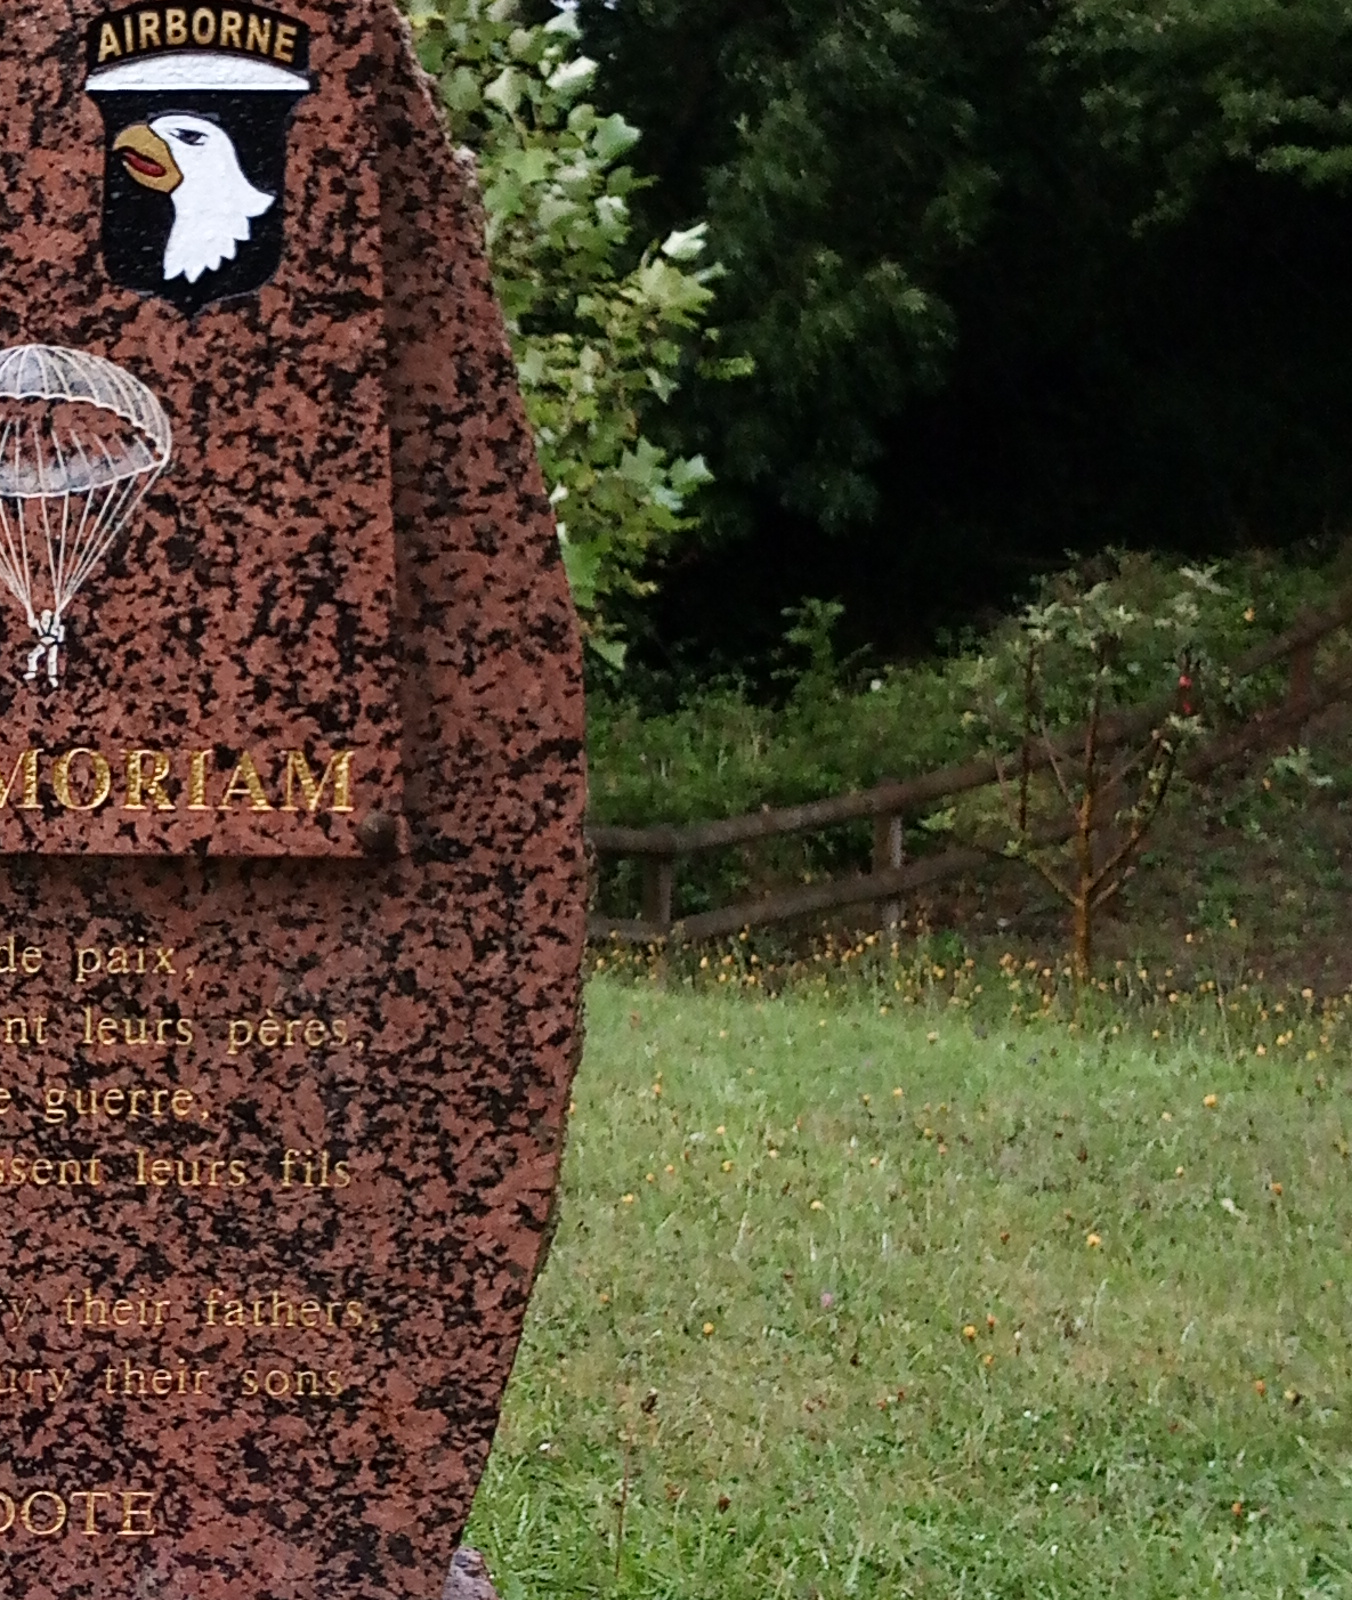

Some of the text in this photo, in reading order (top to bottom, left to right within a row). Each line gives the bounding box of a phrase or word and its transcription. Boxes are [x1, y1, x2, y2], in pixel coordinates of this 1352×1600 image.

[97, 6, 298, 63] AIRBORNE
[75, 935, 196, 983] paix,
[82, 1005, 195, 1047] leurs
[225, 1008, 366, 1055] pères,
[43, 1084, 211, 1125] guerre,
[134, 1147, 248, 1188] leurs
[279, 1147, 352, 1189] fils
[62, 1287, 172, 1328] their
[203, 1287, 381, 1333] fathers,
[103, 1357, 211, 1397] their
[240, 1367, 345, 1398] sons
